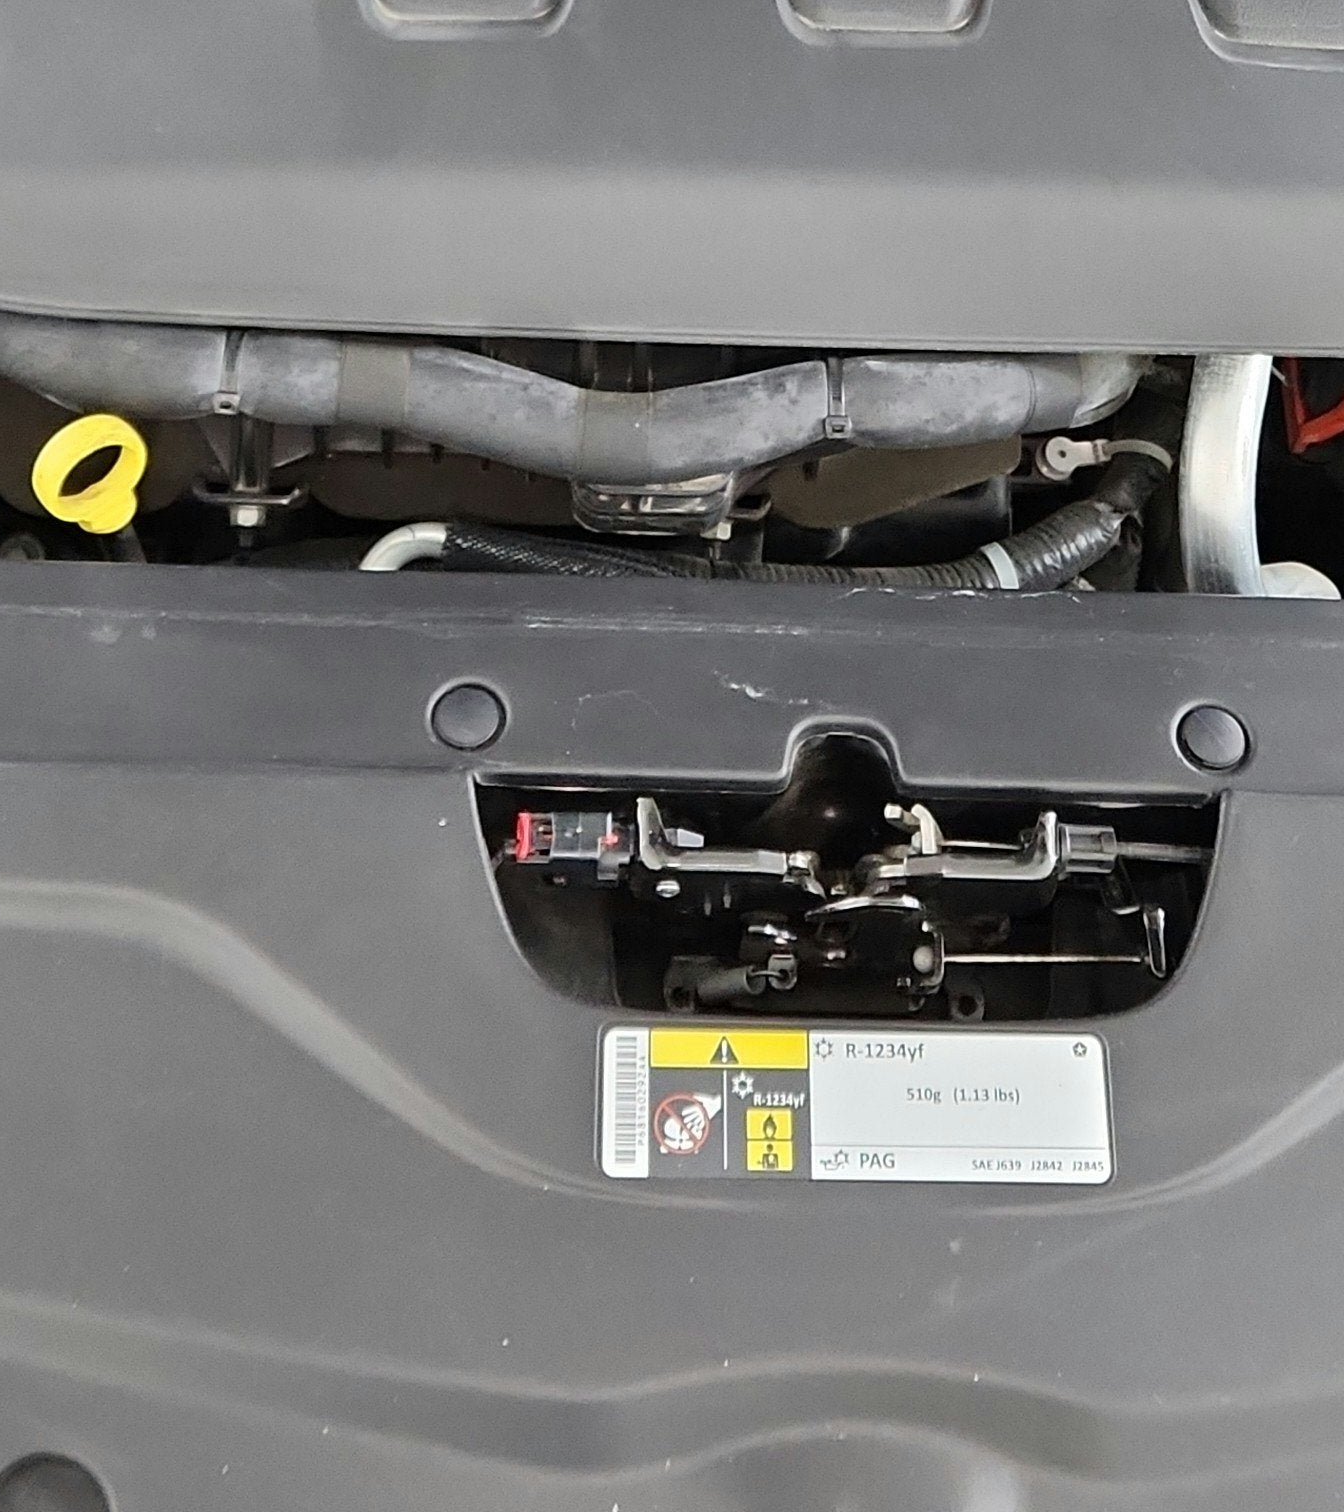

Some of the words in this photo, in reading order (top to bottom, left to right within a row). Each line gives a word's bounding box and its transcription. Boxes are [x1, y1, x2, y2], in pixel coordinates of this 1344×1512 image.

[845, 1042, 925, 1061] R-1234yf
[753, 1091, 805, 1110] R-1234yf
[906, 1087, 942, 1104] 510g
[953, 1087, 989, 1105] (1.13
[993, 1087, 1021, 1105] lbs)
[859, 1151, 896, 1170] PAG
[972, 1159, 993, 1171] SAE
[996, 1159, 1022, 1171] J639
[1030, 1160, 1063, 1171] J2842
[1072, 1161, 1104, 1172] J2845
